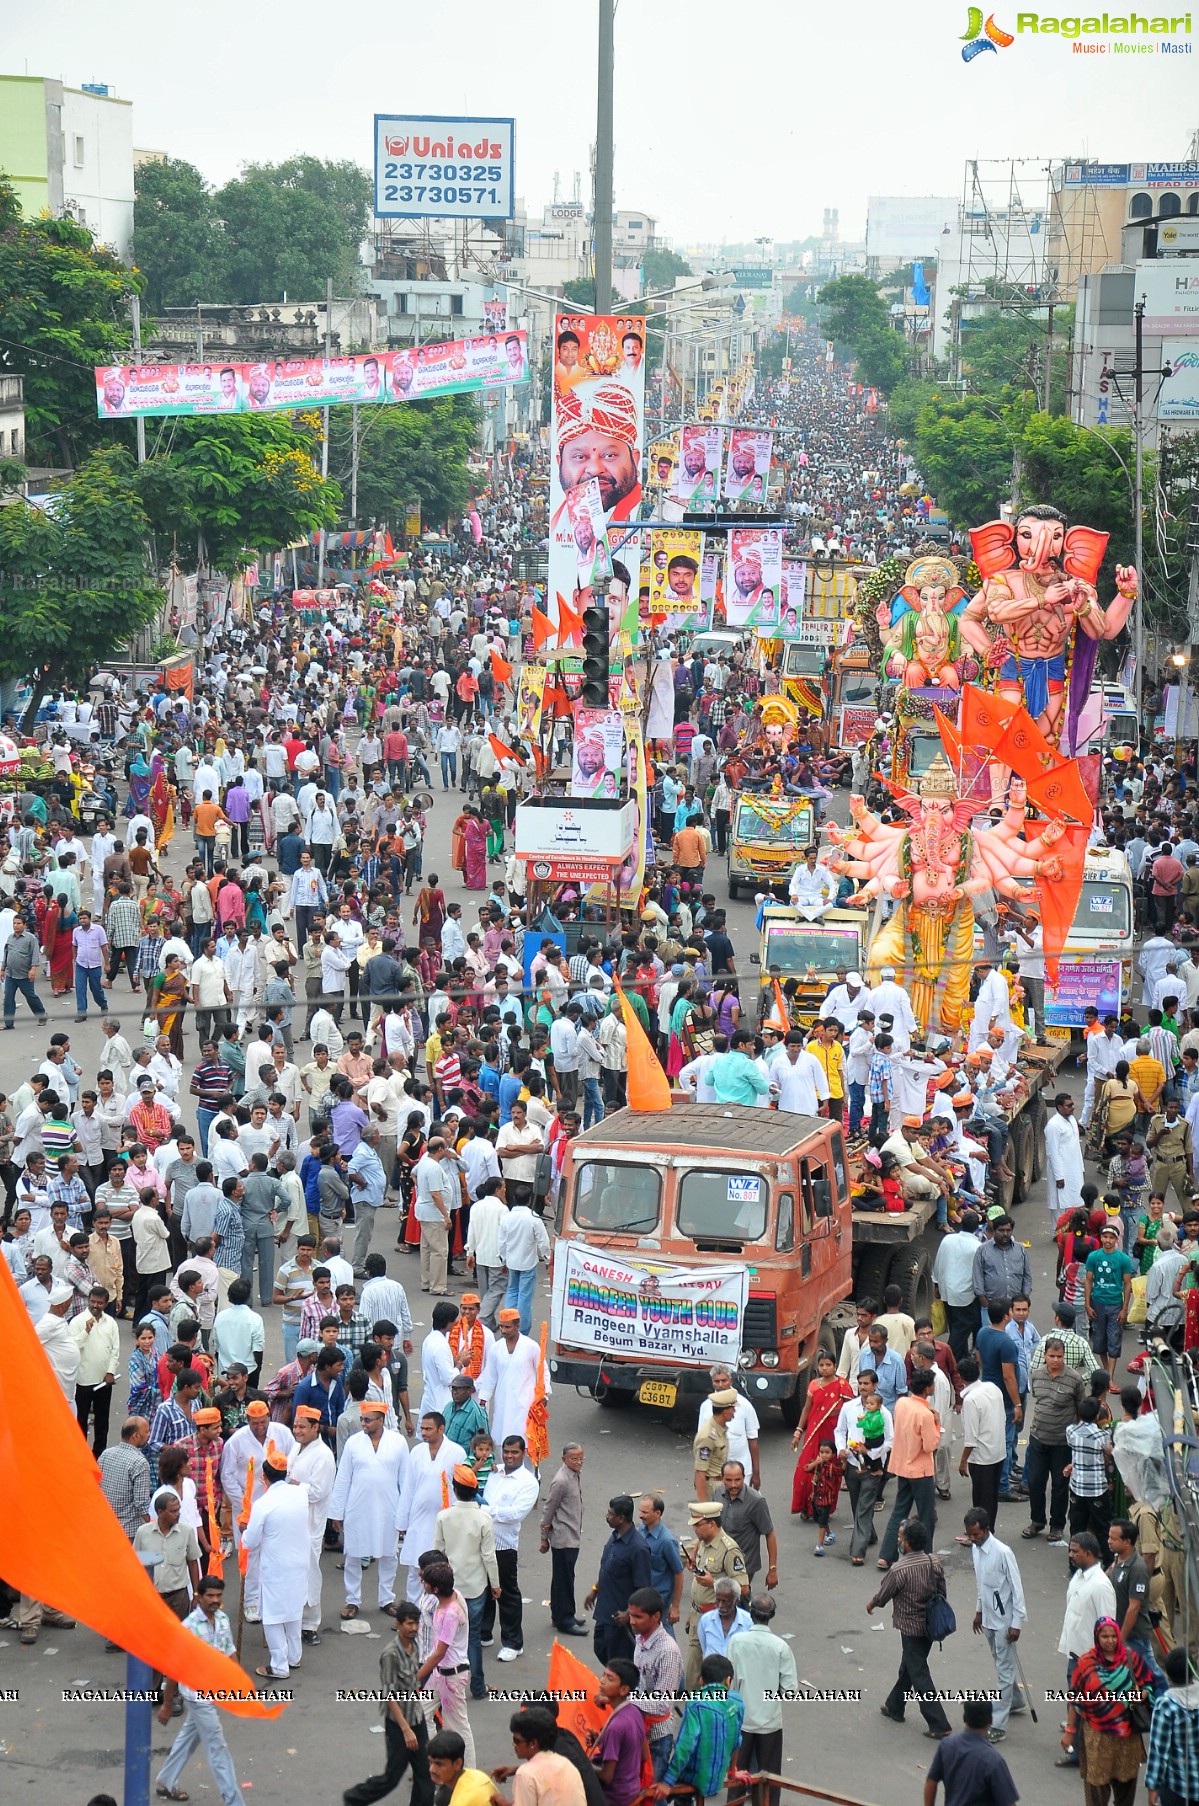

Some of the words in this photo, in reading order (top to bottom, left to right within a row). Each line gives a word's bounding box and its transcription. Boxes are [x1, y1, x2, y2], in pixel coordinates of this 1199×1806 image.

[384, 162, 502, 182] 23730325
[384, 185, 502, 204] 23730571.
[551, 209, 583, 218] LODGE
[1163, 231, 1177, 239] Yale
[265, 576, 271, 587] 7
[584, 864, 610, 872] EXPECT
[570, 872, 610, 880] UNEXPECTED
[730, 1178, 759, 1190] W/Z
[728, 1189, 742, 1200] No.
[743, 1191, 757, 1200] 807
[582, 1261, 633, 1284] GANESH
[567, 1278, 637, 1318] RANGEEN
[638, 1295, 693, 1326] YOUTH
[694, 1299, 739, 1330] CLUB
[573, 1308, 636, 1335] Rangeen
[643, 1323, 729, 1345] Vyamshalla
[593, 1330, 633, 1347] Begum
[638, 1338, 676, 1354] Bazar,
[682, 1344, 708, 1357] Hyd.
[645, 1383, 669, 1393] CG07
[641, 1392, 671, 1405] C3687
